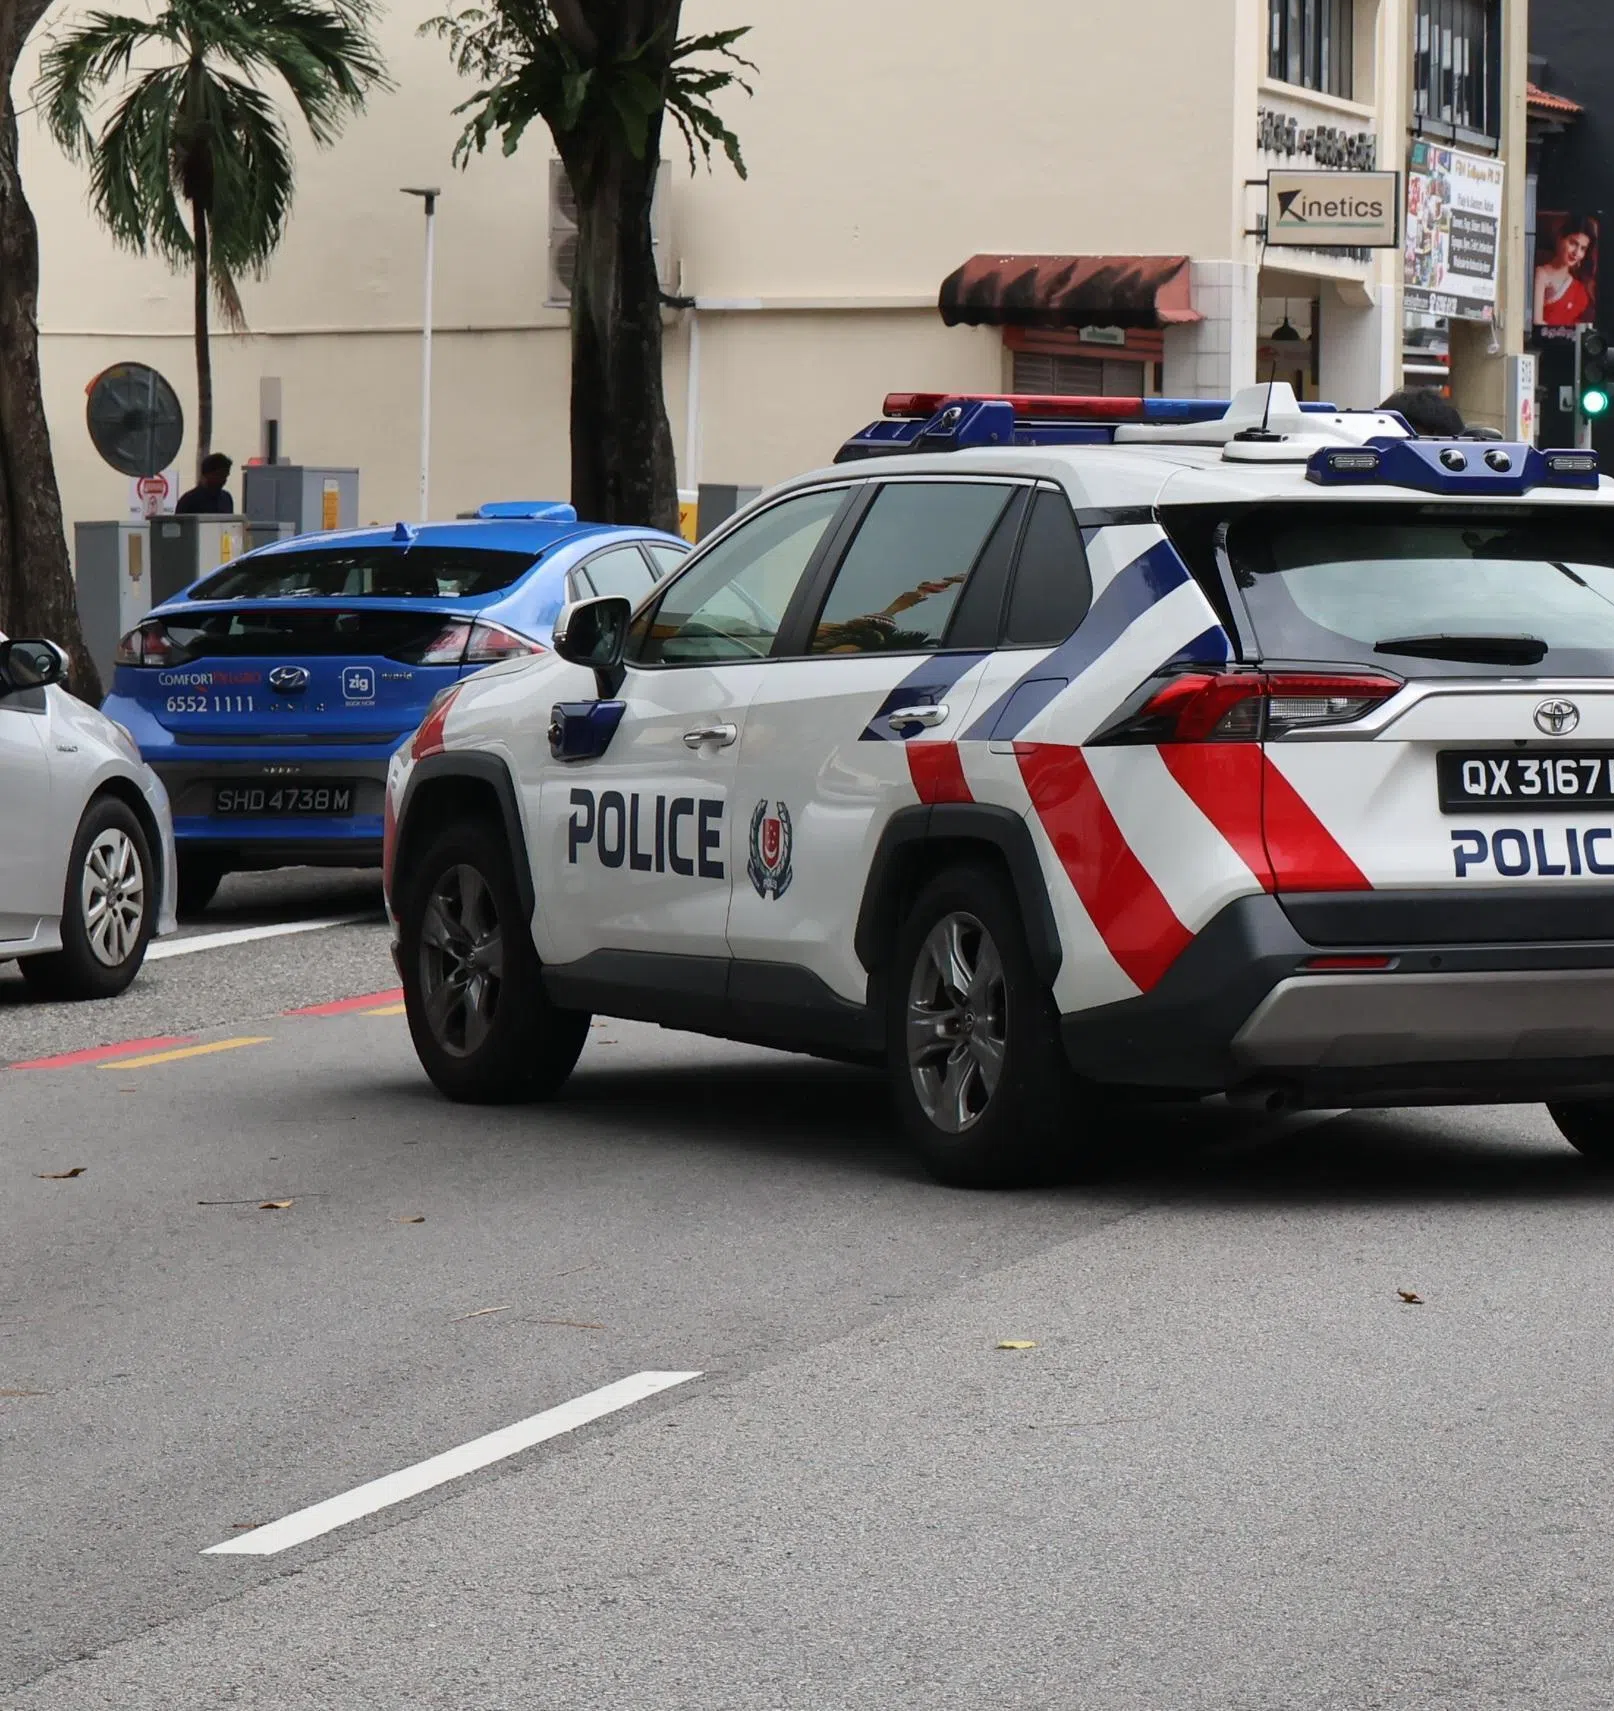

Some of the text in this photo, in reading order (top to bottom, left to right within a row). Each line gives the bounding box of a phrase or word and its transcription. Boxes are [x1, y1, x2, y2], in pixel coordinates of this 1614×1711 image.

[1276, 189, 1383, 223] Kinetics
[348, 673, 369, 691] zig
[166, 696, 208, 712] 6552
[213, 696, 255, 712] 1111
[1462, 760, 1513, 795] QX
[1517, 759, 1601, 795] 3167
[217, 789, 350, 811] SHD 4738 M
[568, 787, 725, 880] POLICE
